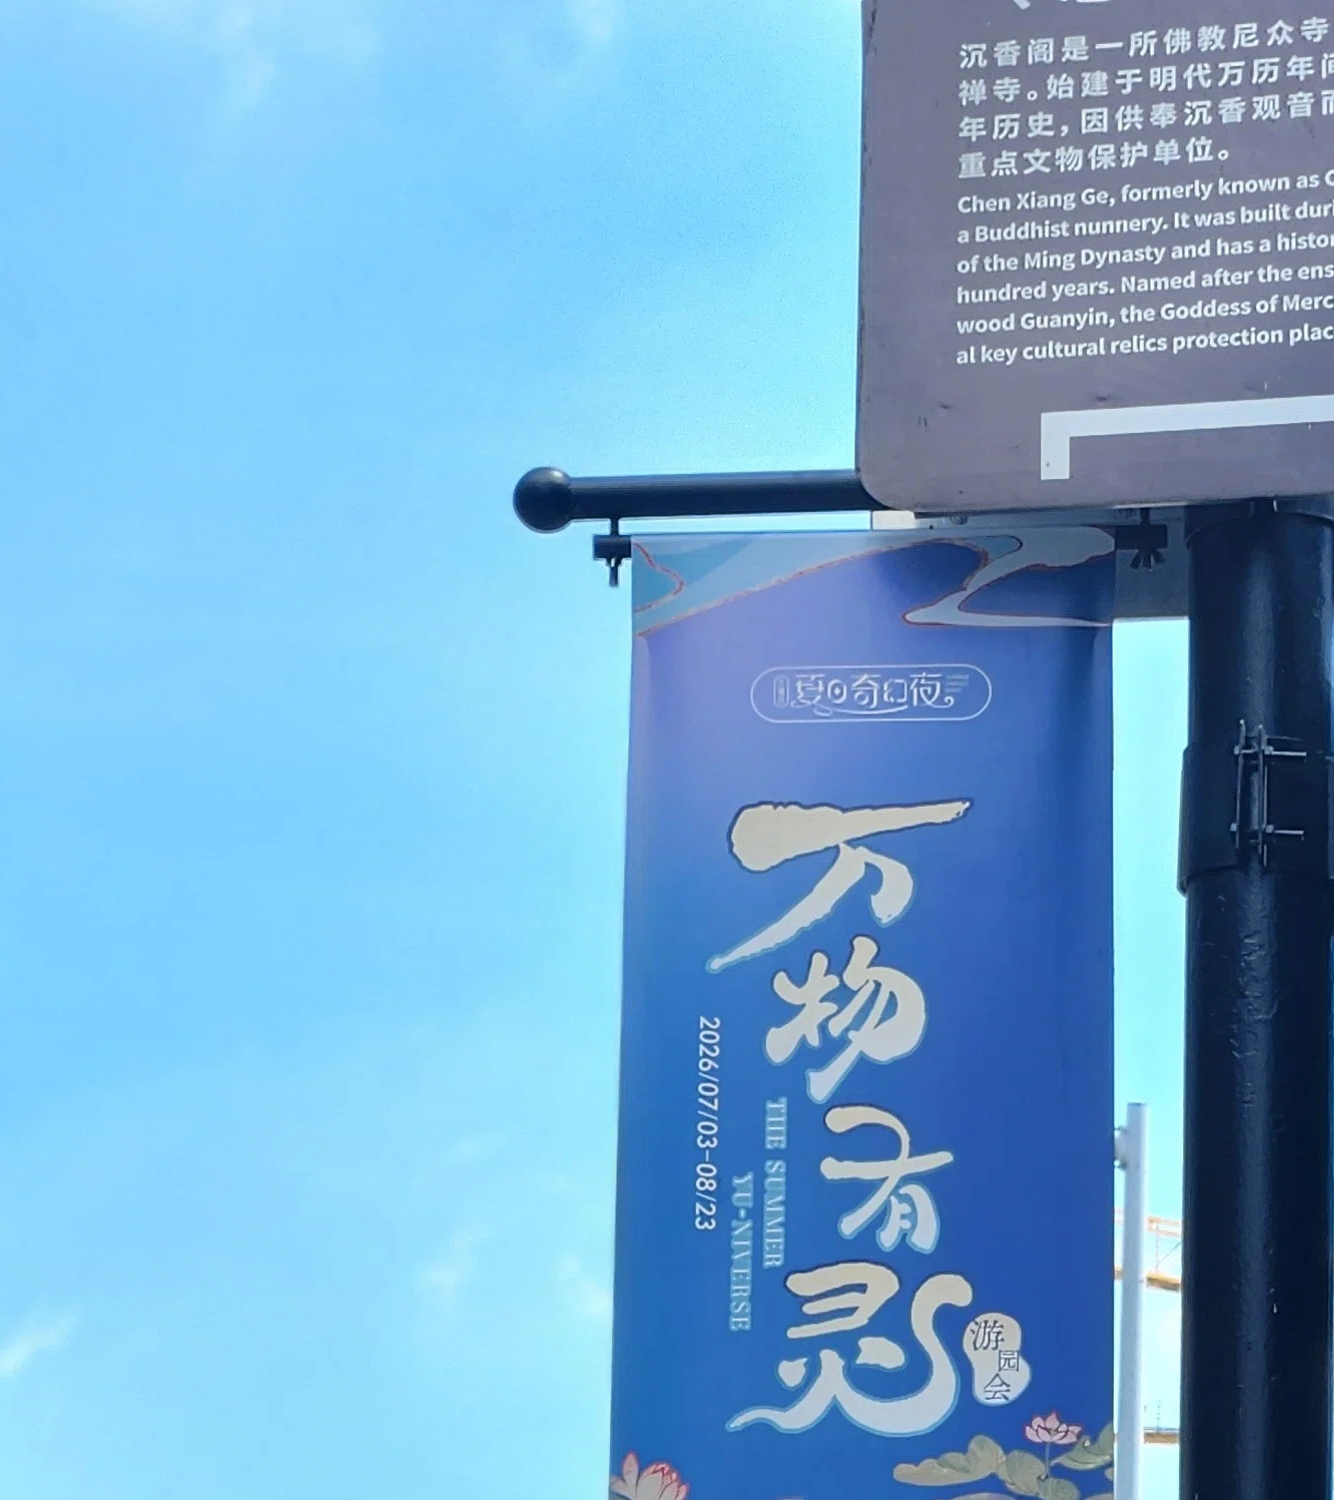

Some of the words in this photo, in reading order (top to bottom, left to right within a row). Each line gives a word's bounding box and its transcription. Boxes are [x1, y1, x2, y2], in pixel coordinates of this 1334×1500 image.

[958, 136, 1230, 179] 重点文物保护单位。
[957, 195, 1010, 213] Chen
[1016, 191, 1076, 211] Xiang
[1080, 188, 1115, 207] Ge,
[1120, 180, 1213, 202] formerly
[1218, 177, 1290, 195] known
[1295, 174, 1319, 188] as
[956, 230, 969, 243] a
[974, 220, 1069, 242] Buddhist
[1074, 217, 1168, 236] nunnery.
[1174, 212, 1190, 228] It
[1193, 211, 1235, 227] was
[1240, 203, 1290, 224] built
[956, 255, 979, 273] of
[983, 254, 1018, 272] the
[1024, 250, 1075, 271] Ming
[1080, 245, 1166, 269] Dynasty
[1170, 239, 1210, 259] and
[1216, 238, 1254, 255] has
[1258, 239, 1271, 252] a
[956, 281, 1046, 304] hundred
[1051, 281, 1115, 302] years.
[1121, 270, 1195, 293] Named
[1201, 268, 1253, 287] after
[1256, 265, 1292, 283] the
[956, 313, 1015, 334] wood
[1020, 307, 1115, 330] Guanyin,
[1119, 305, 1155, 323] the
[1160, 299, 1251, 320] Goddess
[1255, 294, 1279, 313] of
[956, 346, 975, 364] al
[980, 345, 1017, 365] key
[1022, 337, 1105, 360] cultural
[1110, 334, 1167, 354] relics
[1172, 327, 1283, 354] protection
[695, 1016, 720, 1231] 2026/07/03-08/23
[706, 799, 974, 1437] 万物有灵
[766, 1098, 787, 1150] THE
[763, 1160, 786, 1268] SUMMER
[730, 1172, 753, 1331] YU-NIVERSE
[970, 1319, 1021, 1402] 游园会
